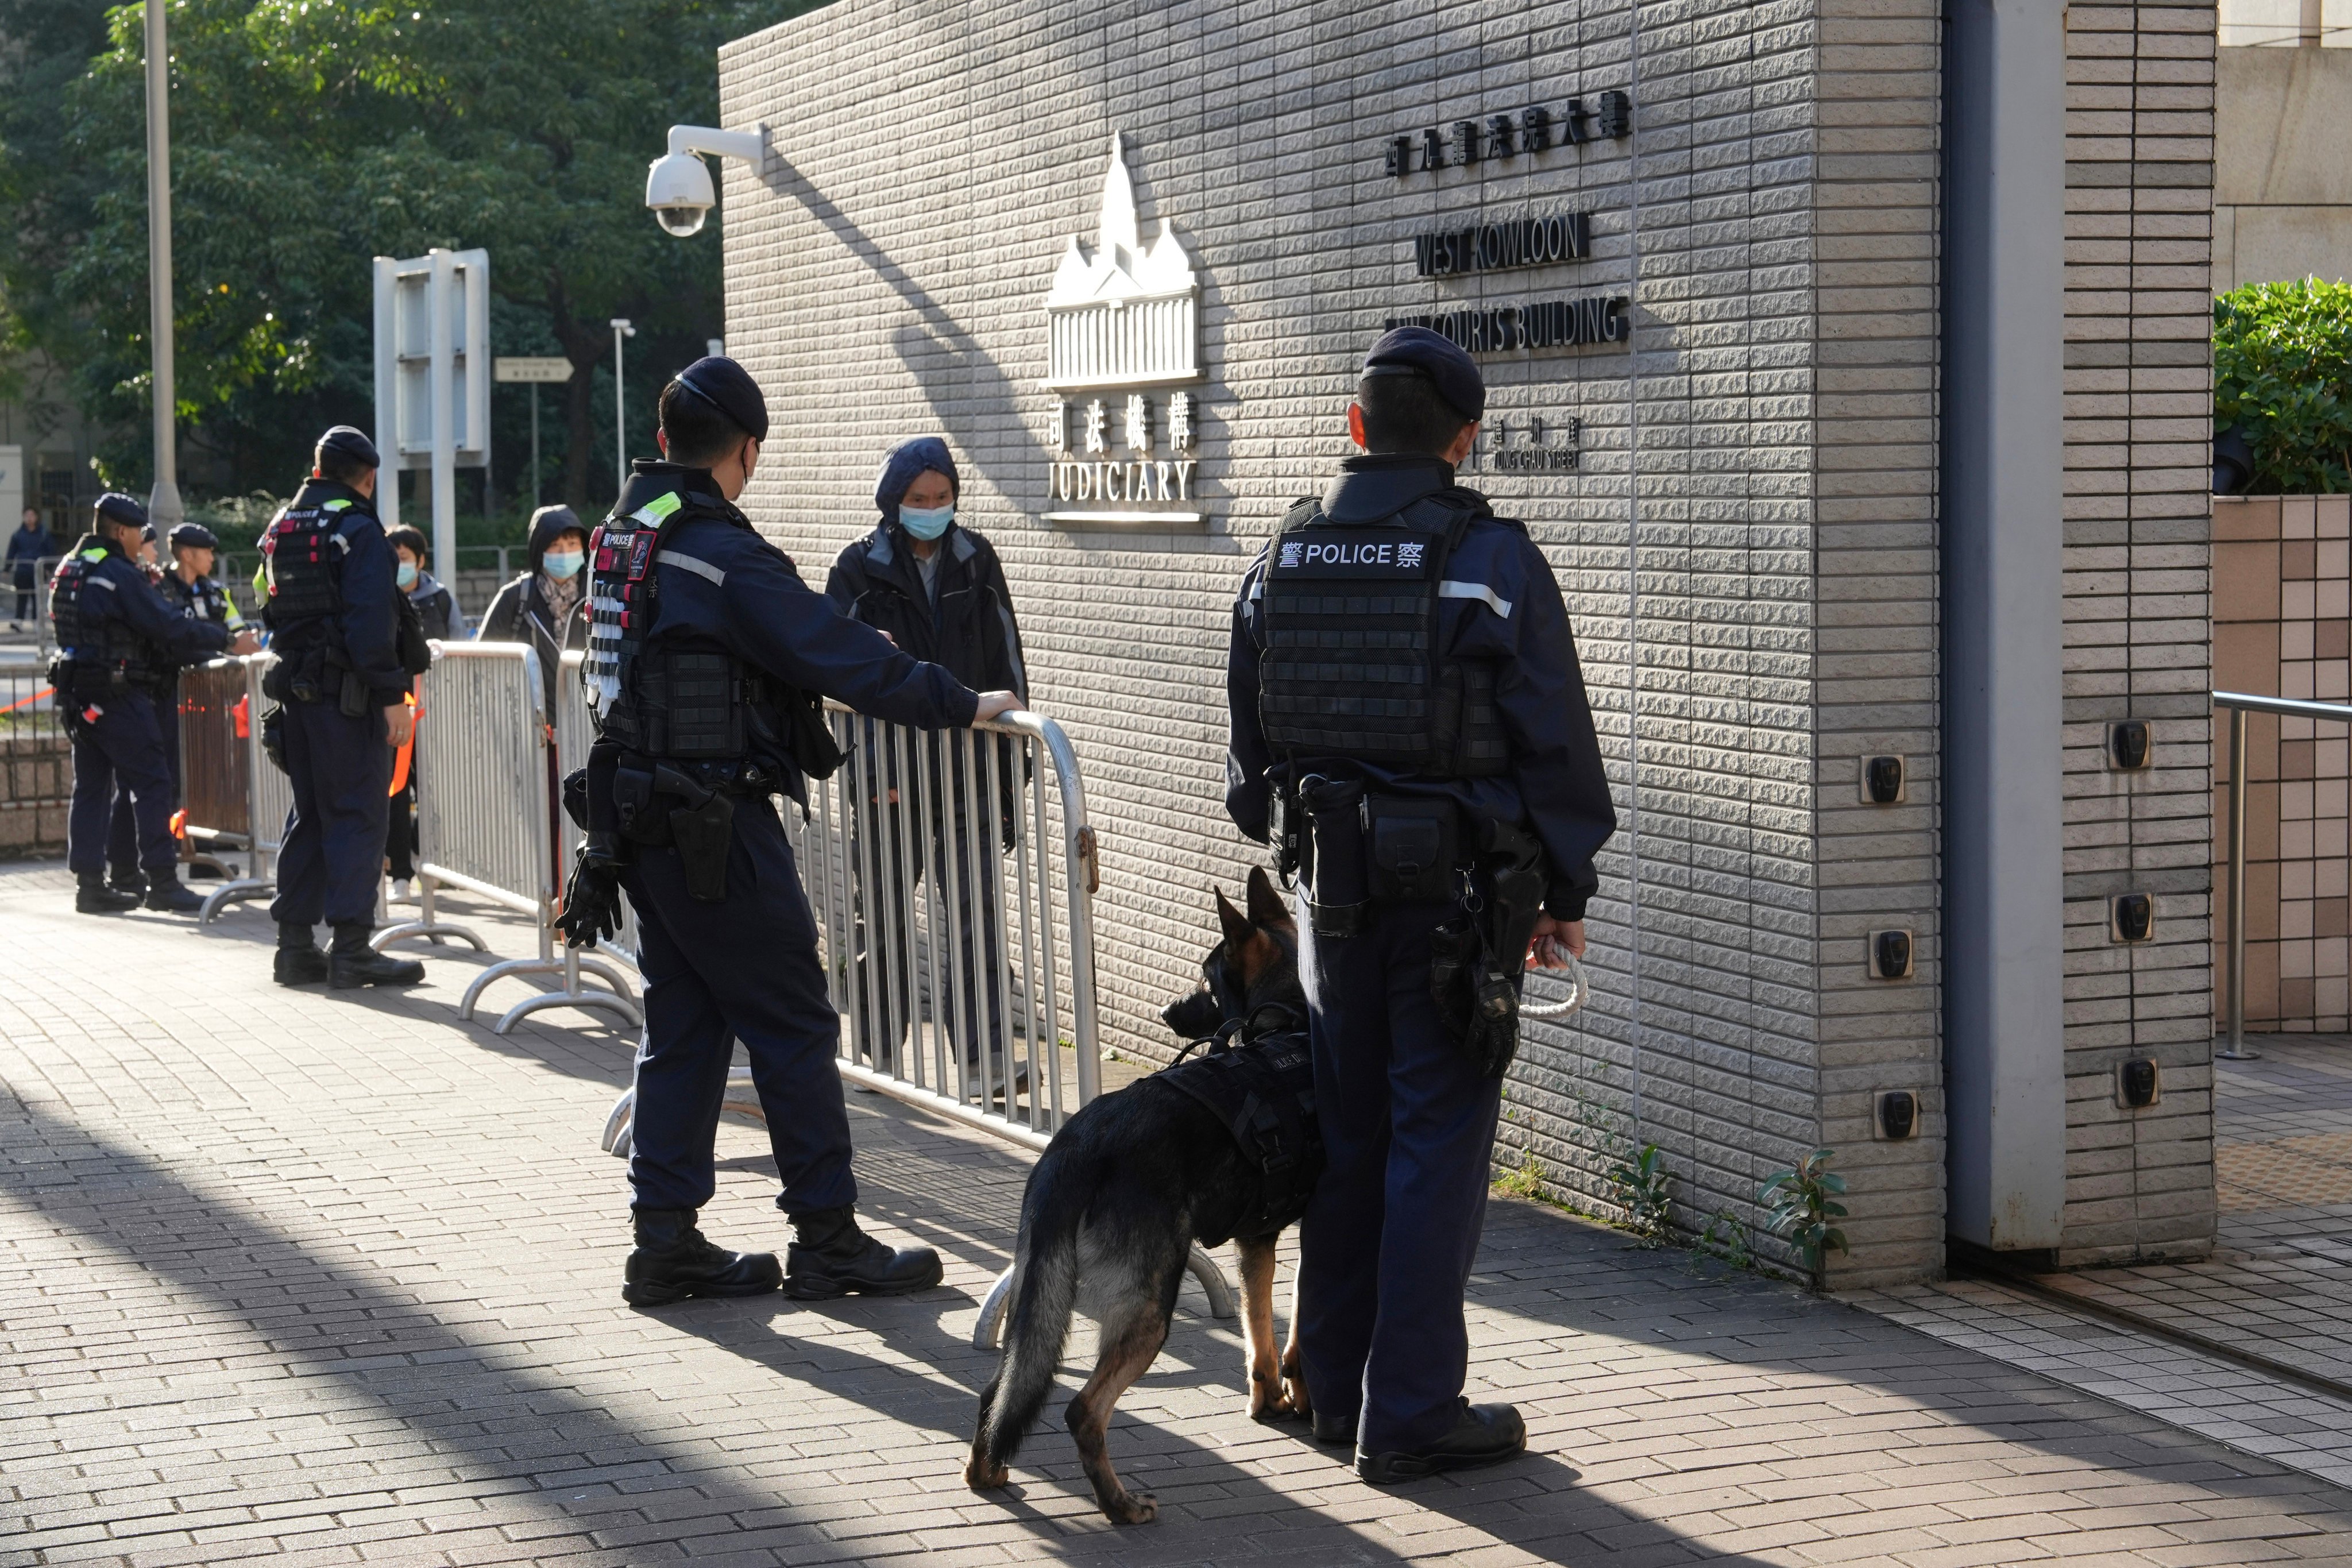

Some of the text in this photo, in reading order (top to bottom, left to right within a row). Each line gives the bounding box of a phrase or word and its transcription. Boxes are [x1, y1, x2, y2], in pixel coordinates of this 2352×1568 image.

[1384, 90, 1629, 176] 西九龍法院大樓
[1415, 213, 1586, 276] WEST KOWLOON
[1516, 296, 1625, 349] BUILDING
[1048, 392, 1192, 453] 司法機構
[1493, 416, 1579, 443] 通州街
[1493, 450, 1516, 469] TUNG
[1521, 450, 1544, 469] CHAU
[1547, 449, 1579, 468] STREET
[1048, 460, 1195, 502] JUDICIARY
[610, 534, 629, 545] POLICE
[1279, 542, 1425, 568] 警 POLICE 察
